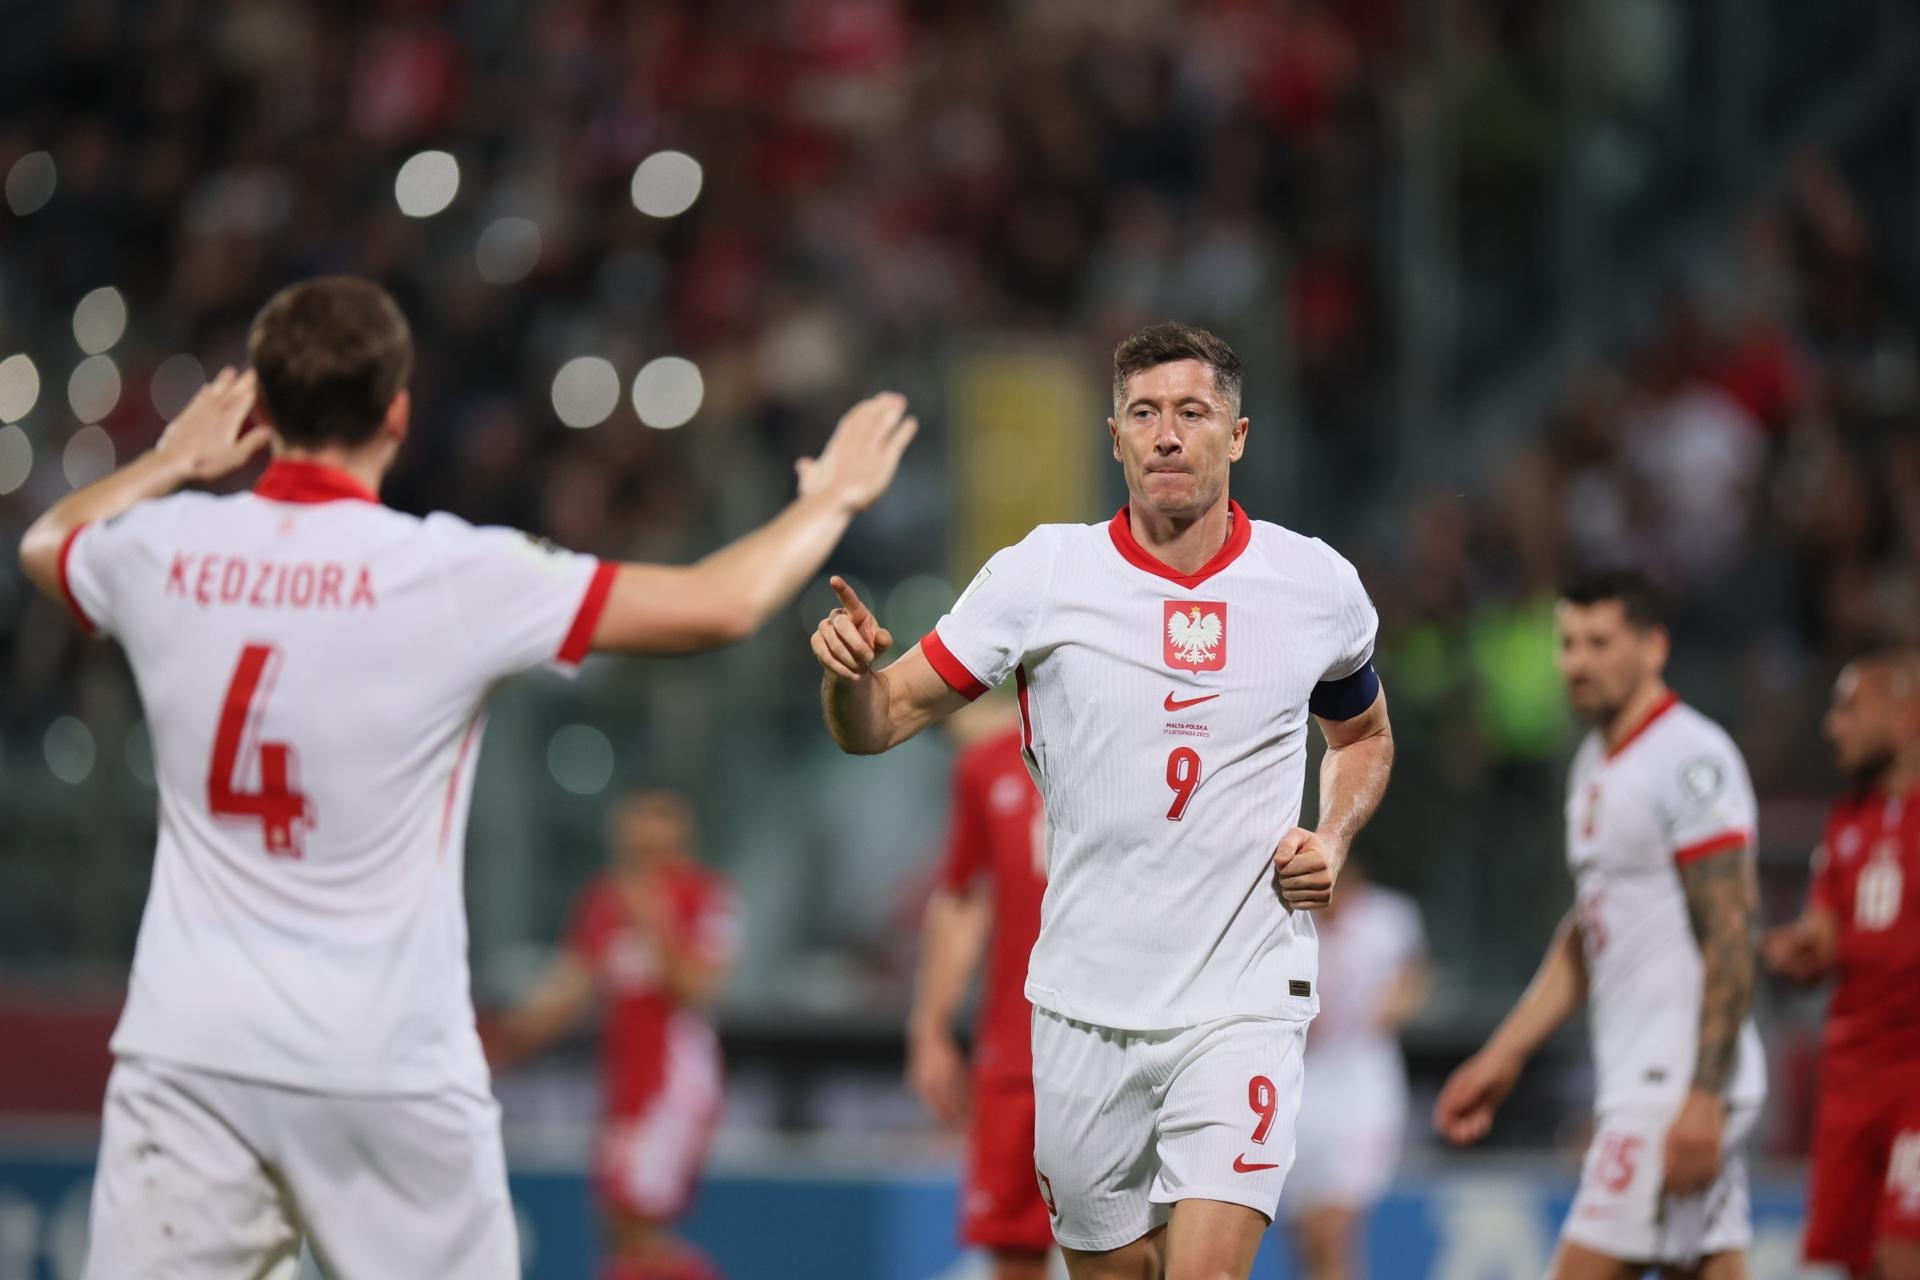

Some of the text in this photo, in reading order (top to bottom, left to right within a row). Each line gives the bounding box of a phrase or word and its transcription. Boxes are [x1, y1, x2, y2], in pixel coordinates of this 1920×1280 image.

[165, 551, 378, 609] KĘDZIORA
[206, 641, 316, 860] 4
[1166, 722, 1208, 731] MALTA-POLSKA
[1166, 746, 1202, 822] 9
[1247, 1075, 1279, 1145] 9
